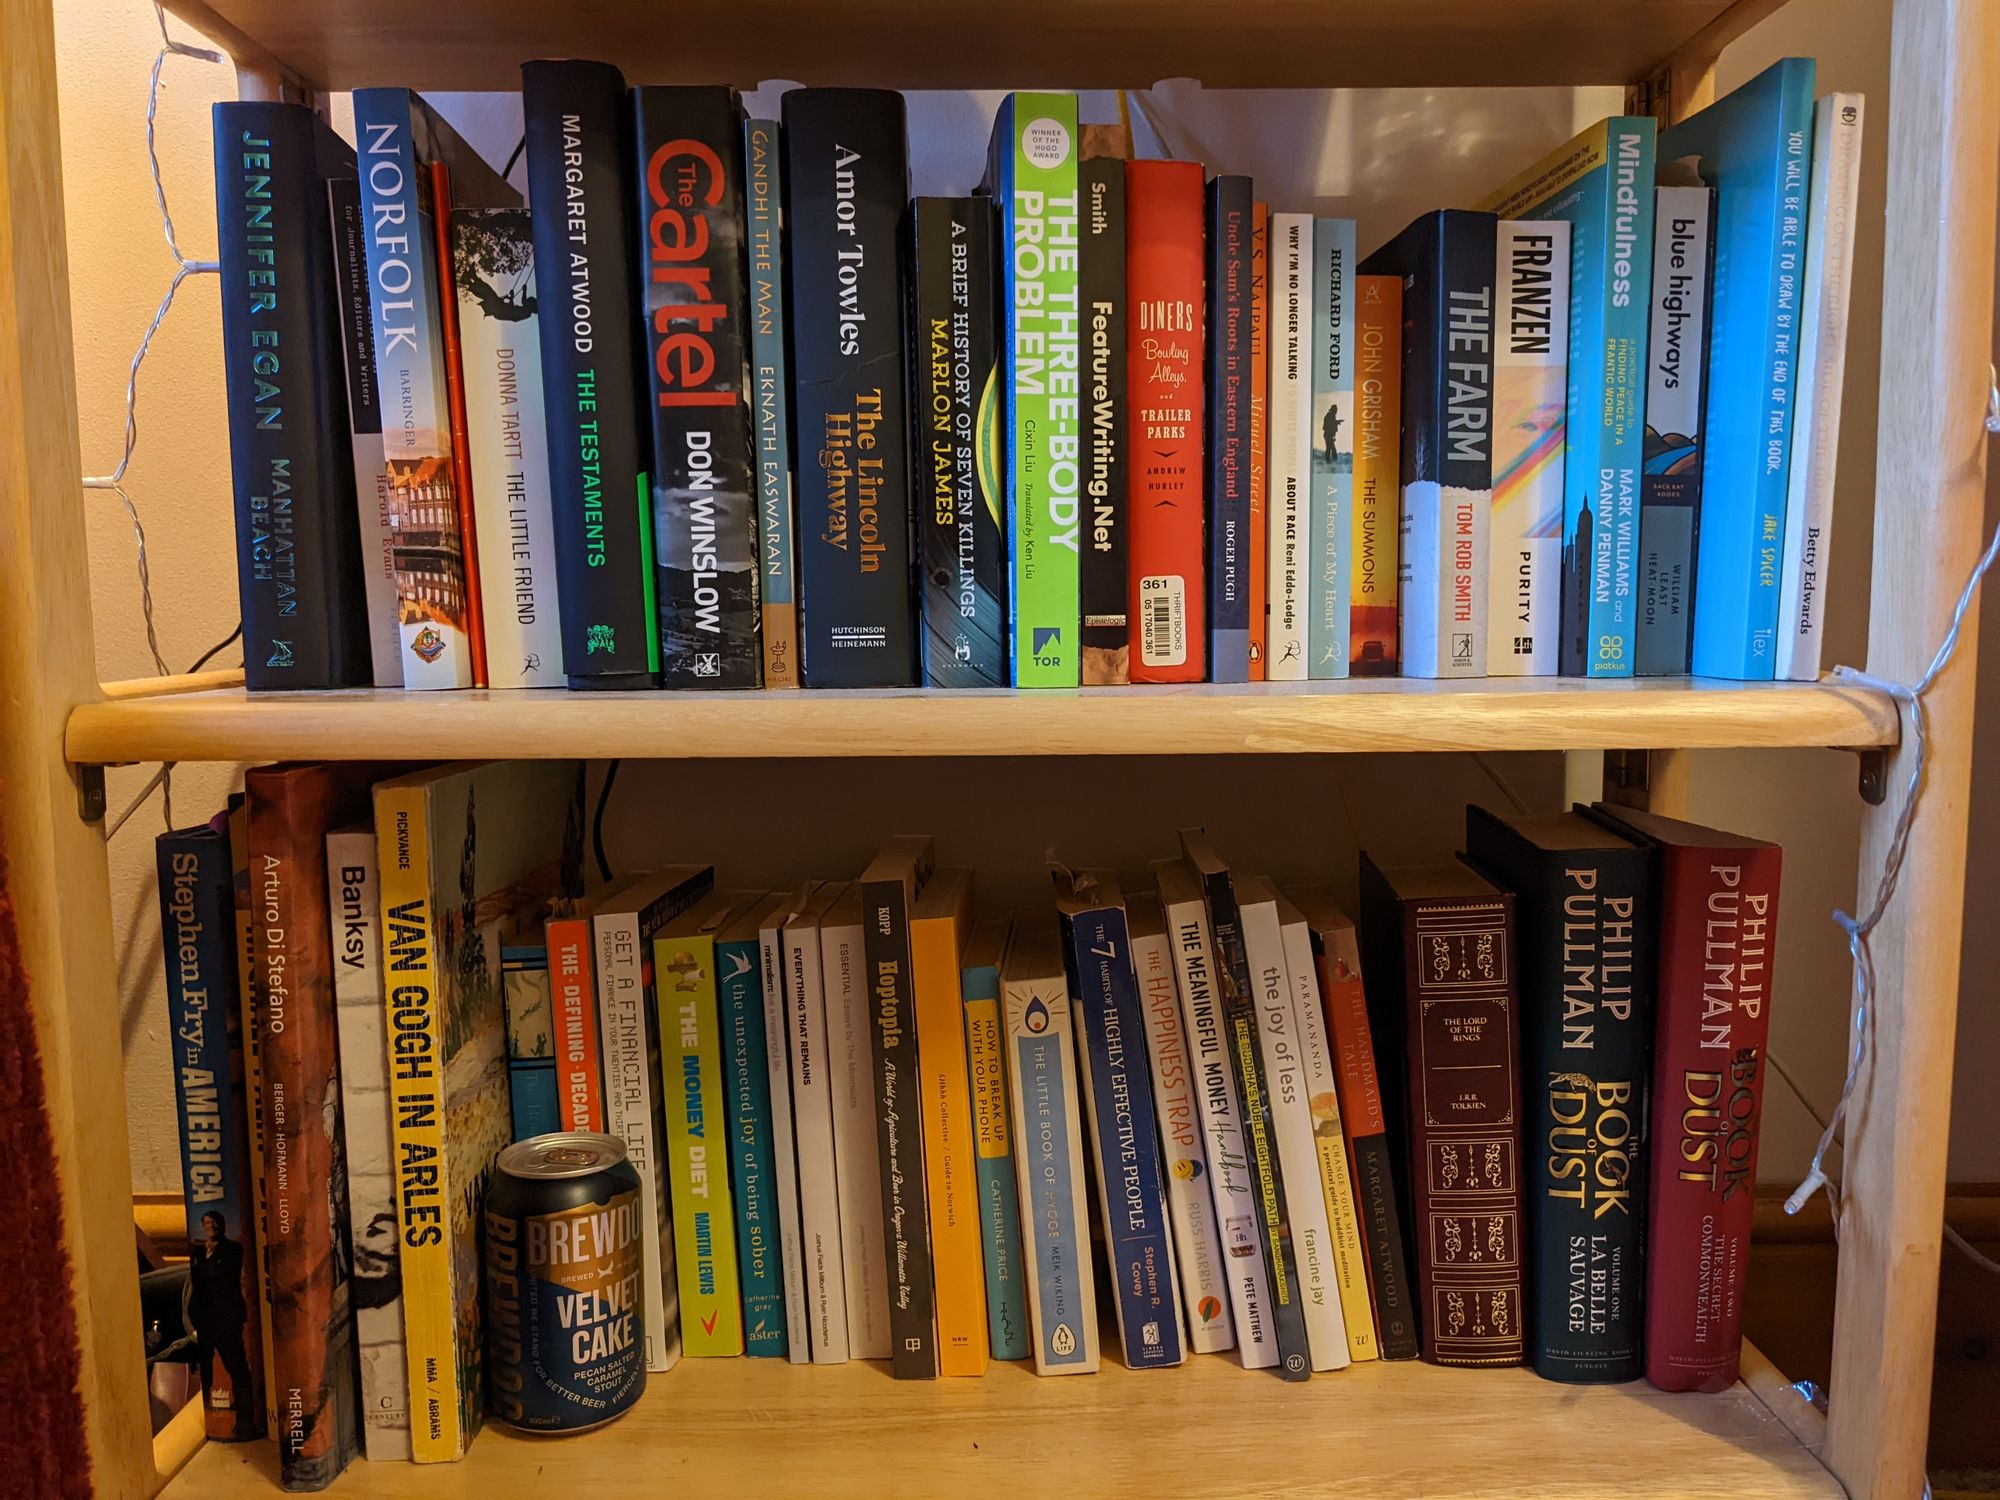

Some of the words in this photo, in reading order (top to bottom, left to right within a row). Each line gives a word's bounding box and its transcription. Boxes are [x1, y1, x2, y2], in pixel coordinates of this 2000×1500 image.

[562, 114, 586, 244] MARGARET
[678, 163, 696, 207] The
[835, 144, 861, 236] Amor
[1092, 183, 1107, 234] Smith
[242, 130, 277, 314] JENNIFER
[366, 121, 417, 358] NORFOLK
[1048, 189, 1078, 272] THE
[1612, 134, 1641, 307] Mindfulness
[1670, 219, 1695, 269] blue
[1782, 217, 1797, 247] ABLE
[570, 253, 593, 353] ATWOOD
[647, 139, 737, 407] Cartel
[838, 244, 866, 355] Towles
[1015, 190, 1045, 394] PROBLEM
[1330, 249, 1341, 328] RICHARD
[1510, 235, 1552, 354] FRANZEN
[353, 297, 365, 338] Editors
[1140, 301, 1192, 332] DINERS
[1288, 293, 1298, 333] LONGER
[1449, 286, 1489, 353] THE
[1659, 275, 1693, 389] highways
[1776, 315, 1791, 328] BY
[252, 330, 283, 430] EGAN
[931, 318, 951, 432] MARLON
[953, 312, 971, 407] HISTORY
[1142, 339, 1189, 365] Bowling
[1606, 338, 1616, 384] FRANTIC
[1618, 338, 1627, 383] FINDING
[400, 369, 416, 447] BARRINGER
[760, 366, 777, 451] EKNATH
[856, 387, 883, 449] The
[1048, 285, 1079, 554] THREE-BODY
[1088, 302, 1114, 552] FeatureWriting.Net
[1141, 409, 1191, 422] TRAILER
[1147, 427, 1186, 439] PARKS
[1226, 375, 1239, 432] Eastern
[1362, 379, 1382, 460] GRISHAM
[1448, 362, 1488, 462] FARM
[686, 431, 712, 490] DON
[1024, 419, 1036, 452] Cixin
[580, 421, 606, 568] TESTAMENTS
[819, 412, 853, 551] Highway
[1222, 437, 1239, 498] England
[376, 475, 390, 527] Harold
[764, 462, 781, 575] EASWARAN
[858, 457, 886, 573] Lincoln
[250, 496, 272, 580] BEACH
[271, 459, 297, 617] MANHATTAN
[382, 538, 394, 579] Evans
[509, 509, 530, 560] LITTLE
[690, 497, 720, 633] WINSLOW
[1362, 511, 1375, 593] SUMMONS
[1616, 521, 1632, 596] WILLIAMS
[514, 568, 535, 625] FRIEND
[1143, 580, 1168, 590] 361
[1454, 575, 1471, 622] SMITH
[1518, 551, 1531, 623] PURITY
[1596, 533, 1611, 602] PENMAN
[1646, 553, 1658, 625] HEAT-MOON
[1659, 573, 1668, 606] LEAST
[1671, 565, 1680, 614] WILLIAM
[1144, 612, 1153, 637] 17040
[1174, 592, 1182, 650] THRIFTBOOKS
[1614, 601, 1624, 622] and
[1799, 571, 1816, 635] Edwards
[1033, 657, 1061, 667] TOR
[1752, 629, 1771, 657] ilex
[396, 812, 410, 870] PICKVANCE
[168, 852, 203, 984] Stephen
[263, 855, 282, 921] Arturo
[342, 866, 369, 969] Banksy
[388, 900, 427, 971] VAN
[878, 906, 891, 936] KOPP
[618, 978, 634, 989] A
[793, 948, 806, 1011] EVERYTHING
[1100, 961, 1112, 992] HABITS
[1148, 950, 1161, 971] THE
[1562, 867, 1597, 1050] PULLMAN
[1600, 896, 1634, 1020] PHILIP
[1699, 864, 1741, 1049] PULLMAN
[1738, 893, 1769, 1019] PHILIP
[179, 987, 208, 1047] Fry
[268, 955, 287, 1033] Stefano
[563, 986, 584, 1062] DEFINING
[875, 960, 903, 1049] Hoptopia
[1186, 956, 1218, 1058] MEANINGFUL
[1350, 990, 1365, 1020] THE
[187, 1046, 201, 1064] in
[391, 986, 433, 1079] GOGH
[620, 1001, 641, 1110] FINANCIAL
[1103, 1008, 1125, 1069] HIGHLY
[1147, 976, 1185, 1090] HAPPINESS
[1299, 975, 1323, 1080] PARAMANANDA
[1453, 1033, 1481, 1042] RINGS
[1204, 1062, 1229, 1116] MONEY
[1278, 1067, 1296, 1104] less
[1343, 1043, 1358, 1081] TALE
[1355, 1026, 1380, 1129] HANDMAID'S
[273, 1083, 284, 1124] BERGER
[940, 1102, 950, 1142] Collective
[978, 1100, 990, 1143] PHONE
[990, 1080, 1001, 1119] BREAK
[1036, 1076, 1049, 1116] LITTLE
[1111, 1074, 1137, 1162] EFFECTIVE
[1167, 1093, 1195, 1146] TRAP
[1450, 1102, 1487, 1110] TOLKIEN
[182, 1066, 224, 1203] AMERICA
[884, 1107, 900, 1156] Agriculture
[1040, 1122, 1054, 1161] BOOK
[1208, 1120, 1248, 1198] Handbook
[1547, 1091, 1587, 1208] DUST
[1586, 1139, 1597, 1156] OF
[1593, 1081, 1631, 1220] BOOK
[1628, 1134, 1639, 1160] THE
[1678, 1071, 1722, 1192] DUST
[1720, 1121, 1730, 1136] OF
[1722, 1062, 1758, 1203] BOOK
[400, 1142, 441, 1248] ARLES
[1123, 1165, 1145, 1231] PEOPLE
[1256, 1137, 1273, 1196] EIGHTFOLD
[1265, 1199, 1278, 1226] PATH
[1332, 1144, 1346, 1186] CHANGE
[1339, 1191, 1350, 1218] YOUR
[1366, 1151, 1388, 1234] MARGARET
[694, 1212, 712, 1257] MARTIN
[745, 1153, 757, 1169] of
[751, 1226, 766, 1278] sober
[991, 1180, 1004, 1245] CATHERINE
[561, 1272, 594, 1284] BREWED
[1131, 1262, 1144, 1297] Covey
[1144, 1247, 1158, 1294] Stephen
[1151, 1297, 1161, 1309] R.
[1193, 1241, 1213, 1291] HARRIS
[1611, 1247, 1621, 1293] VOLUME
[1695, 1214, 1713, 1343] COMMONWEALTH
[1714, 1234, 1725, 1263] THE
[1727, 1237, 1738, 1286] VOLUME
[556, 1268, 640, 1329] VELVET
[1243, 1277, 1256, 1299] PETE
[1568, 1236, 1586, 1332] SAUVAGE
[1590, 1269, 1606, 1334] BELLE
[1710, 1268, 1724, 1323] SECRET
[571, 1311, 634, 1365] CAKE
[749, 1332, 781, 1341] aster
[1247, 1302, 1263, 1344] MATTHEW
[574, 1364, 606, 1380] PECAN
[587, 1366, 627, 1386] CARAMEL
[594, 1376, 622, 1394] STOUT
[288, 1388, 304, 1454] MERRELL
[428, 1399, 440, 1439] ABRAMS
